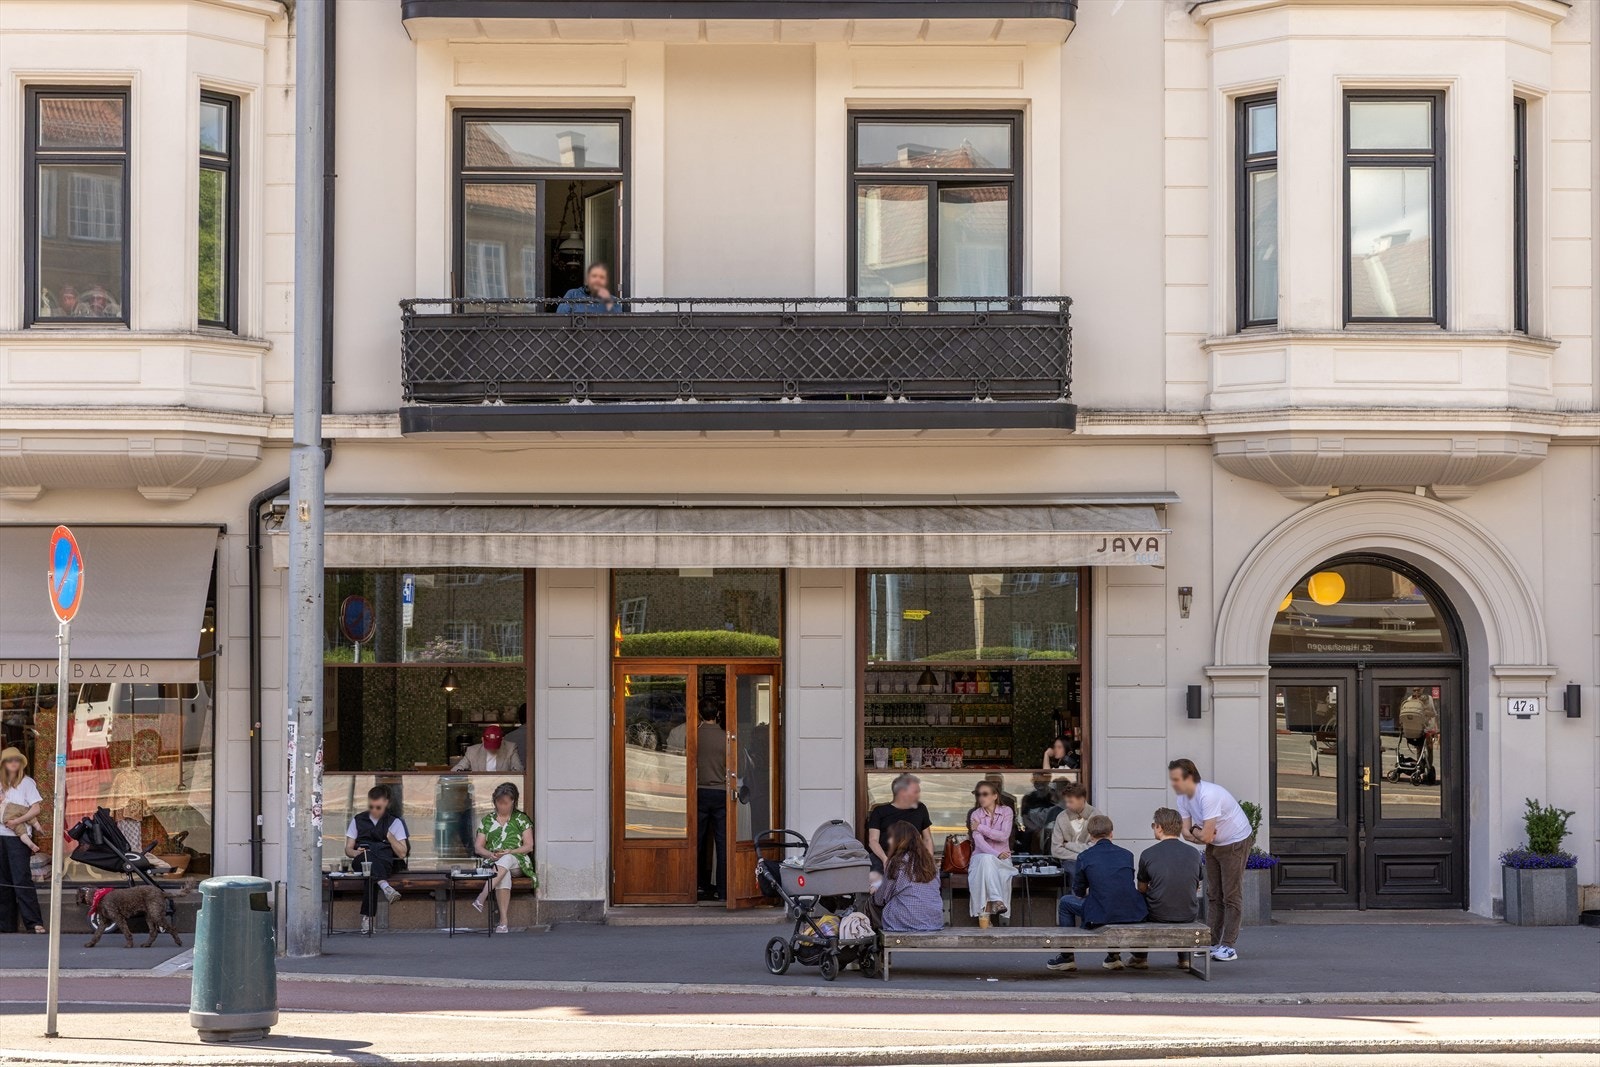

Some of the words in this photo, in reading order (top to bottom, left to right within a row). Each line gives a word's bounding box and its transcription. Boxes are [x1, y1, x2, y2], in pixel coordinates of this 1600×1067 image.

[1097, 537, 1159, 553] JAVA
[74, 664, 150, 678] BAZAR
[1513, 701, 1527, 712] 47
[1529, 704, 1535, 712] a
